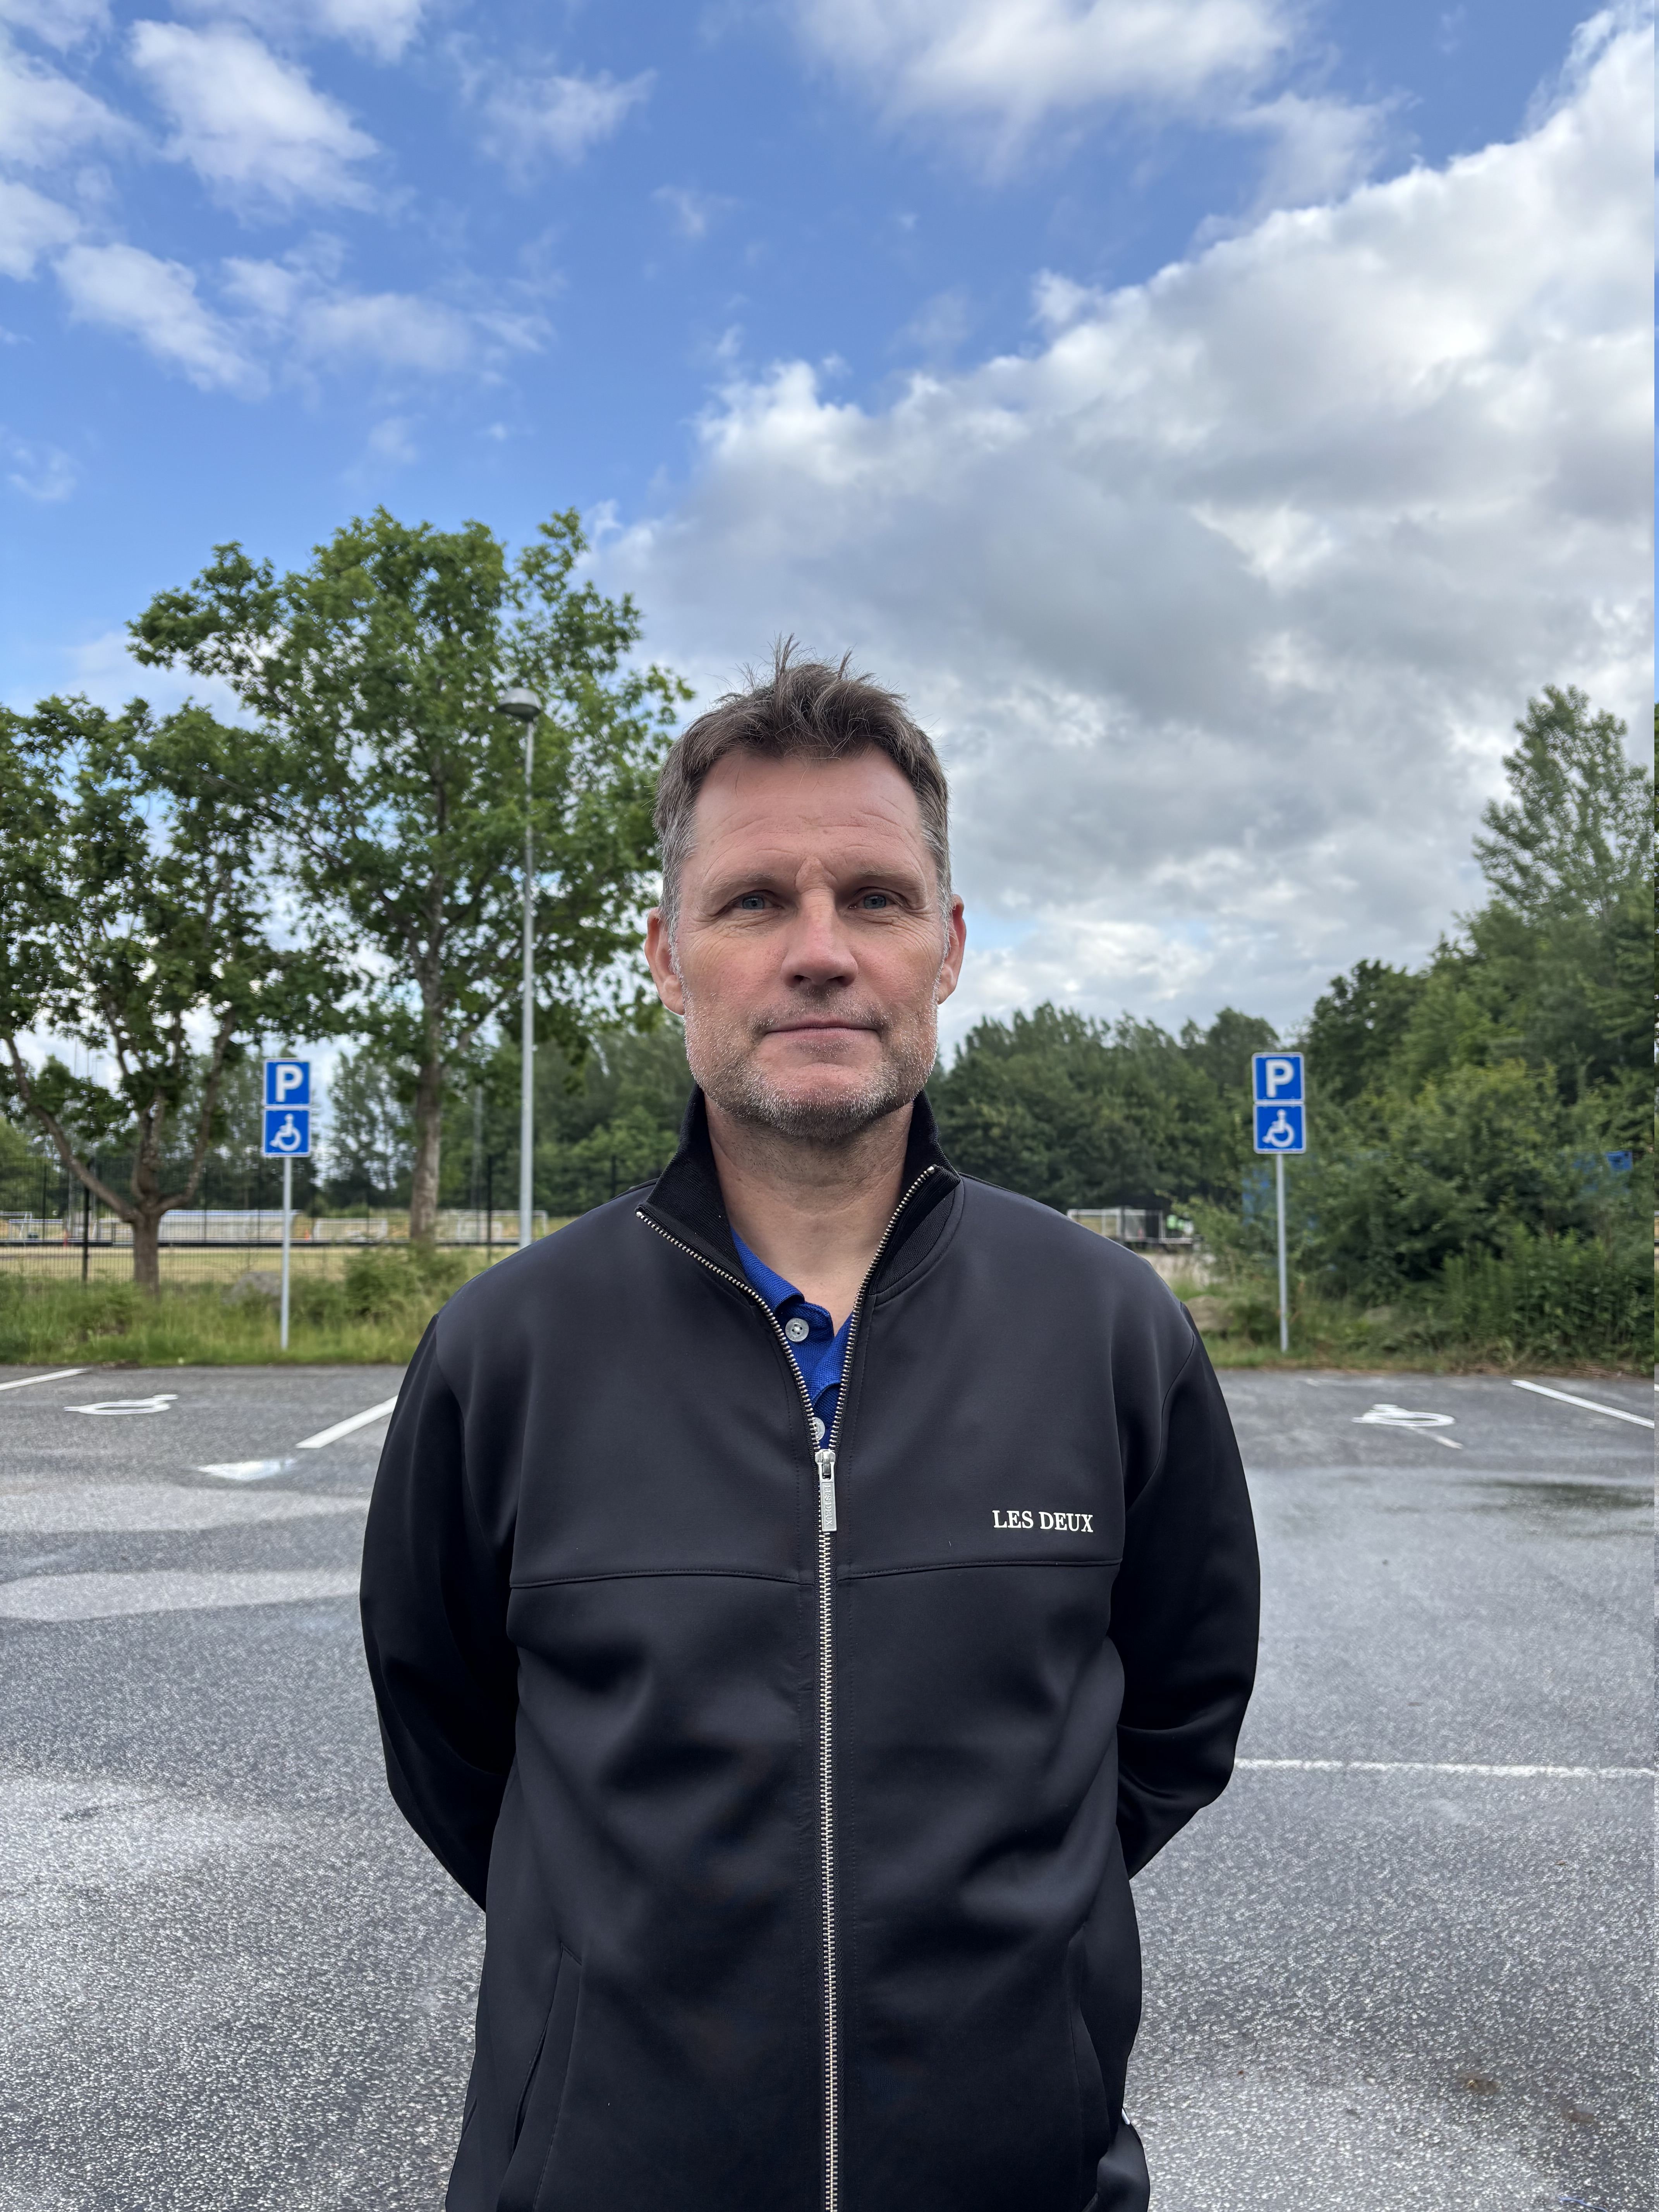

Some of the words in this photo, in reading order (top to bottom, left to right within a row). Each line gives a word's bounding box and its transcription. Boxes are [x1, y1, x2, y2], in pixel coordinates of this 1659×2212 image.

[276, 1065, 303, 1102] P
[1266, 1059, 1294, 1097] P
[992, 1510, 1034, 1528] LES
[1038, 1511, 1094, 1533] DEUX
